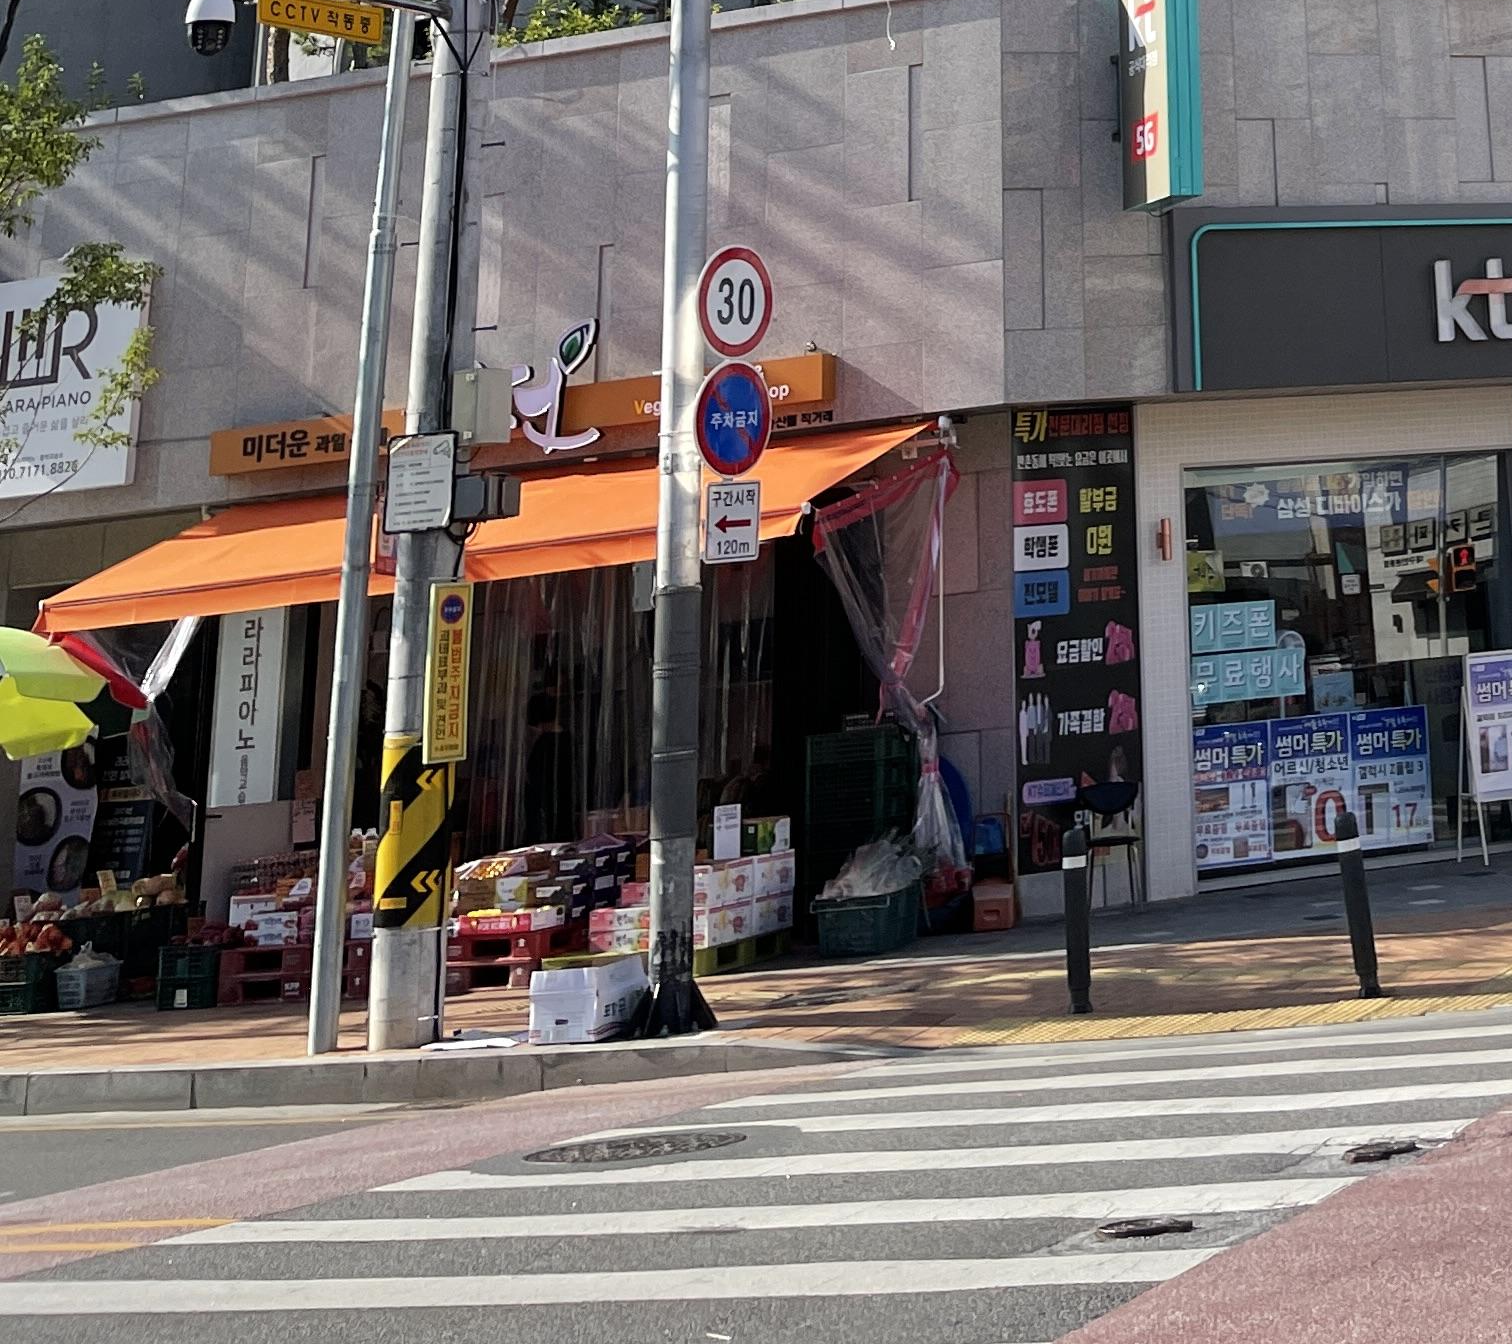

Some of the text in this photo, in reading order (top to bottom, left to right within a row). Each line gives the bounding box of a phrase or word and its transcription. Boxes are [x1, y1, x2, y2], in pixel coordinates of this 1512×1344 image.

[270, 0, 371, 34] CCTV 작동중
[1136, 121, 1155, 155] 5G
[717, 277, 755, 325] 30
[4, 390, 91, 413] ARA PIANO
[710, 410, 759, 430] 주차금지
[1014, 411, 1048, 443] 특가
[242, 429, 346, 463] 미더운 과일
[711, 488, 756, 507] 구간시작
[1023, 490, 1058, 515] 효도폰
[1080, 486, 1118, 513] 할부금
[1277, 496, 1311, 519] 삼성
[716, 539, 750, 556] 120m
[1086, 525, 1112, 555] 0원
[1193, 606, 1271, 640] 키즈폰
[1056, 637, 1104, 664] 요금할인
[235, 616, 264, 750] 라라피아노
[1195, 653, 1301, 690] 무료행사
[1476, 680, 1507, 703] 썸머
[1057, 707, 1105, 736] 가족결합
[1194, 742, 1264, 771] 썸머 특가
[1275, 730, 1344, 758] 썸머 특가
[1356, 729, 1422, 756] 썸머 특가
[1392, 802, 1417, 828] 17
